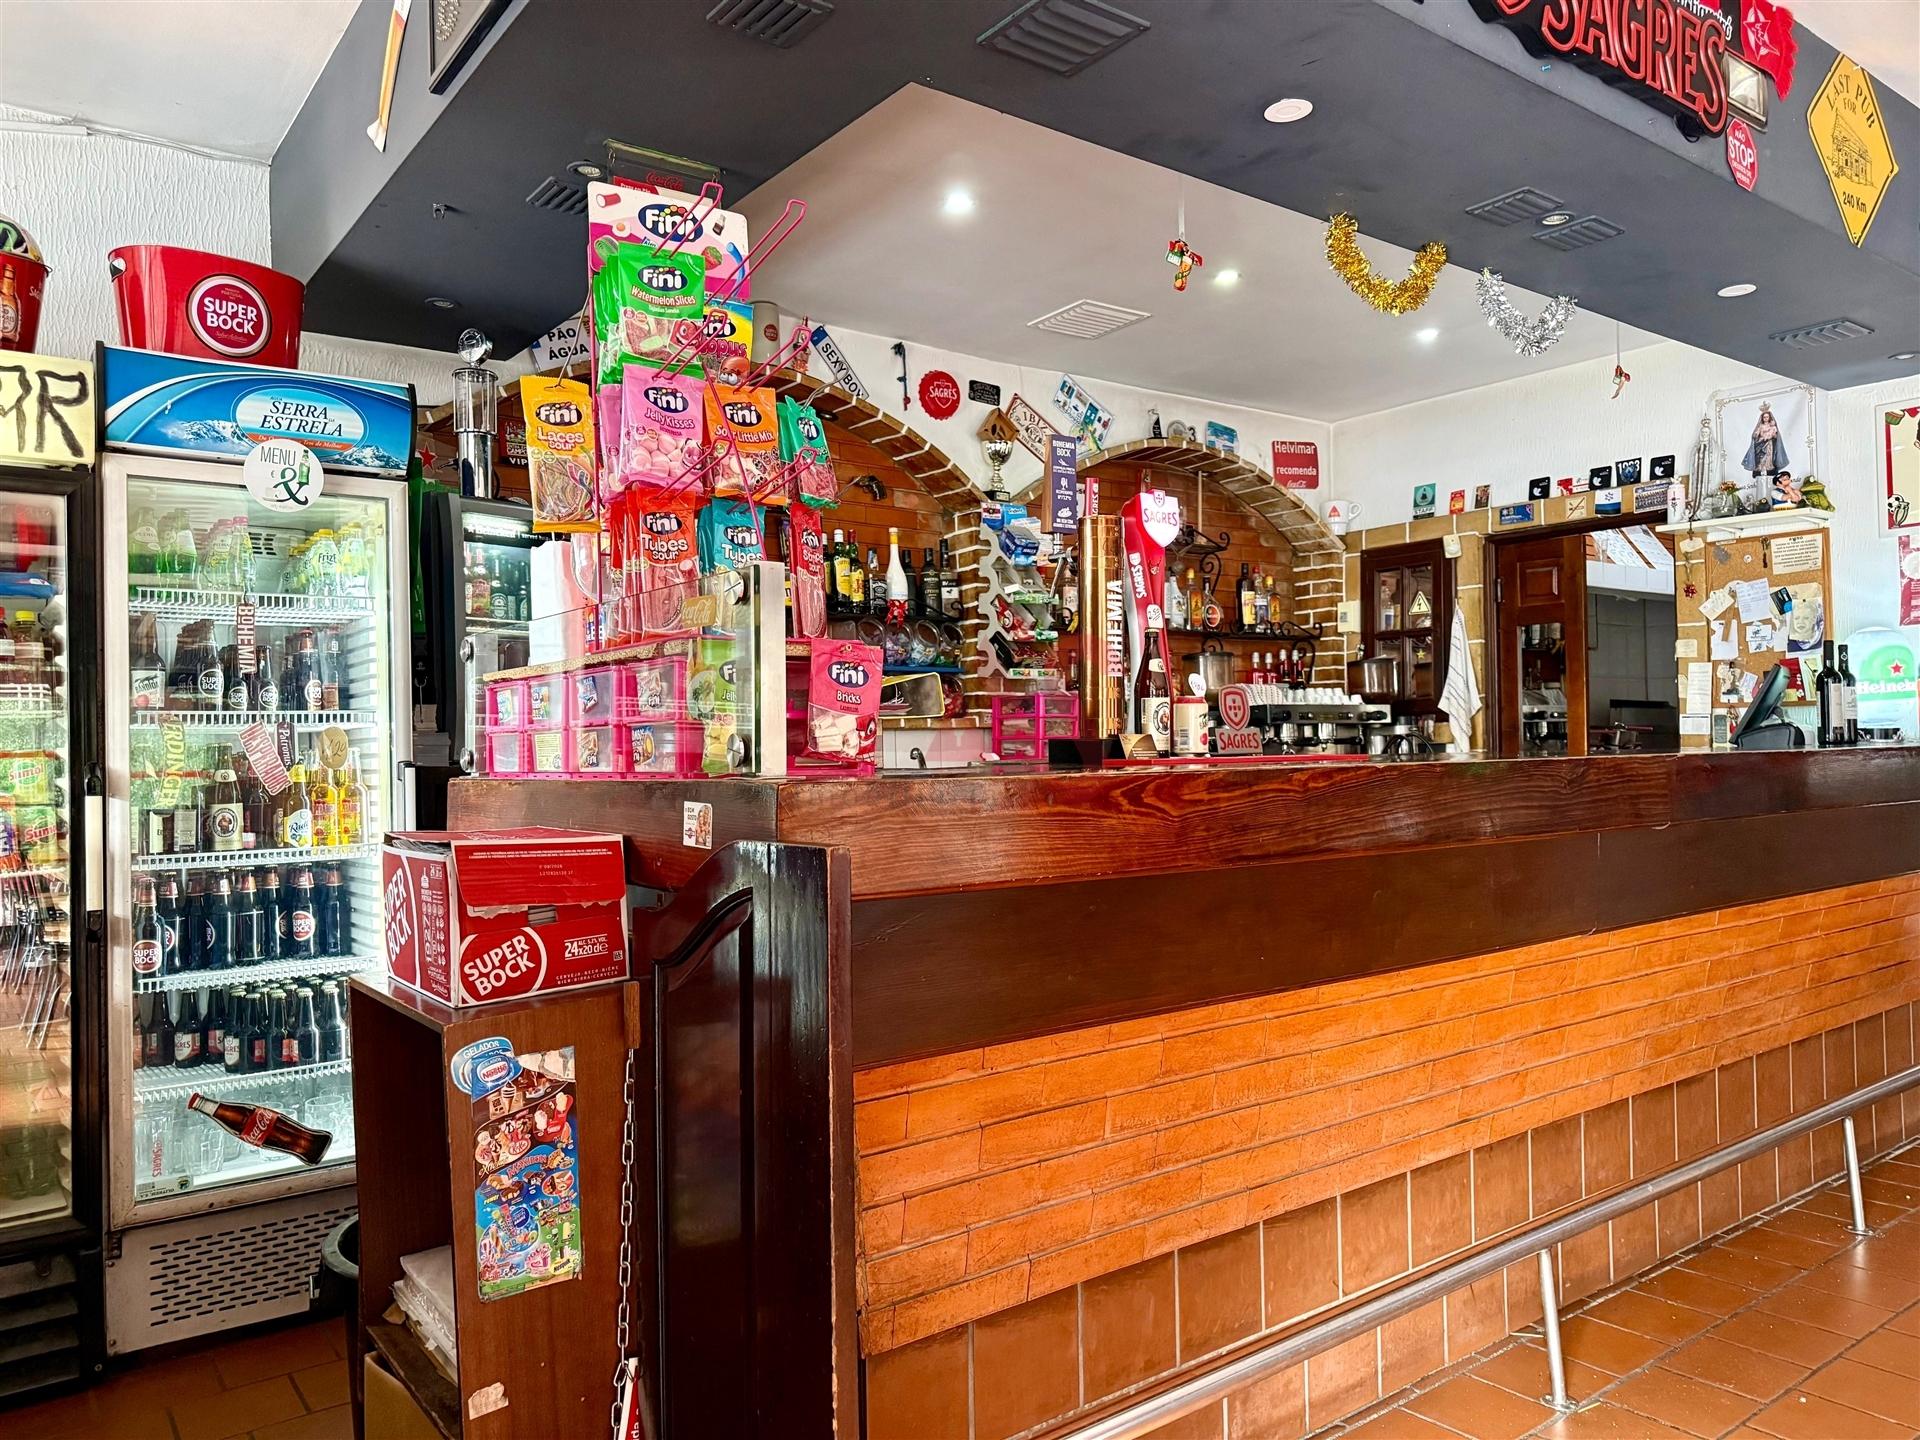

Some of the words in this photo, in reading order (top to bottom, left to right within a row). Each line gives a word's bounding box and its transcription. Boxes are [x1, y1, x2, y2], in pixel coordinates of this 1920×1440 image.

[1542, 0, 1729, 133] SAGRES
[1826, 74, 1851, 112] LAST
[1855, 83, 1877, 129] PUB
[1842, 97, 1857, 115] FOR
[1735, 129, 1746, 142] NÃO
[1728, 135, 1754, 169] STOP
[1842, 191, 1855, 209] 240
[1855, 197, 1868, 214] Km
[645, 208, 695, 240] Fini
[642, 268, 682, 289] Fini
[631, 285, 676, 305] Watermelon
[675, 293, 697, 306] Slices
[203, 297, 258, 322] SUPER
[206, 312, 255, 336] BOCK
[702, 318, 731, 336] ini
[548, 327, 577, 342] PÃO
[549, 343, 590, 361] ÁGUA
[822, 342, 847, 374] SEXY
[843, 373, 864, 398] BOY
[649, 389, 683, 411] Fini
[929, 386, 958, 400] SAGRES
[270, 401, 328, 420] SERRA
[540, 405, 578, 424] Fini
[645, 408, 667, 427] Jelly
[666, 416, 695, 429] Kisses
[725, 404, 757, 424] Fini
[260, 415, 343, 437] ESTRELA
[1022, 411, 1049, 432] IBIZ
[537, 426, 585, 443] Laces
[715, 424, 737, 441] Sor
[738, 430, 760, 443] Little
[760, 431, 775, 441] Mix
[1053, 440, 1075, 450] BOHEMIA
[1056, 449, 1071, 457] BOCK
[1274, 441, 1316, 455] Helvimar
[260, 446, 297, 467] MENU
[1276, 464, 1317, 476] recomenda
[646, 513, 678, 532] Fini
[1143, 508, 1178, 526] SAGRES
[642, 533, 688, 551] Tubes
[727, 528, 759, 546] Fini
[652, 549, 679, 560] sour
[721, 543, 763, 563] Tubes
[1131, 565, 1147, 599] SAGRES
[1106, 580, 1123, 678] BOHEMIA
[237, 605, 256, 674] BOHEMIA
[831, 665, 864, 686] Fini
[836, 690, 861, 704] Bricks
[1219, 732, 1261, 750] SAGRES
[9, 763, 44, 781] Sumol
[384, 867, 407, 928] SUPER
[387, 901, 412, 962] BOCK
[463, 935, 531, 982] SUPER
[474, 951, 536, 997] BOCK
[176, 1040, 191, 1049] GRES
[225, 1045, 240, 1053] GRES
